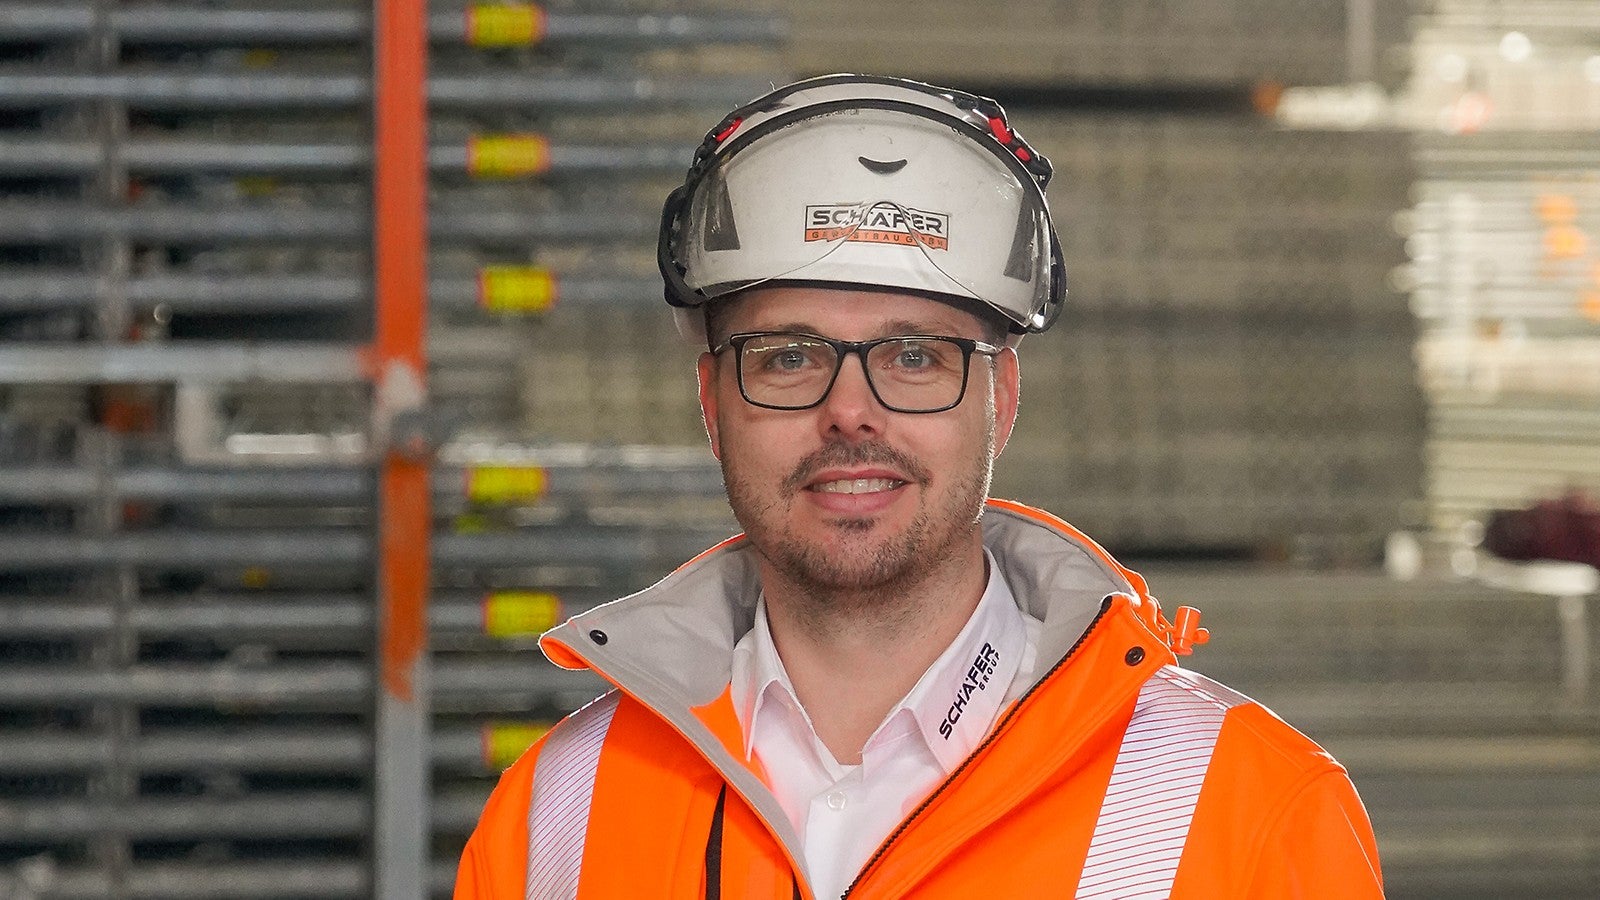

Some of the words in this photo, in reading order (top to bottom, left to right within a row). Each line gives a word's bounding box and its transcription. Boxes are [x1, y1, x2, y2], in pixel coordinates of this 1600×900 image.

[812, 208, 942, 234] SCHÄFER
[939, 642, 995, 740] SCHÄFER
[979, 652, 1000, 691] GROUP
